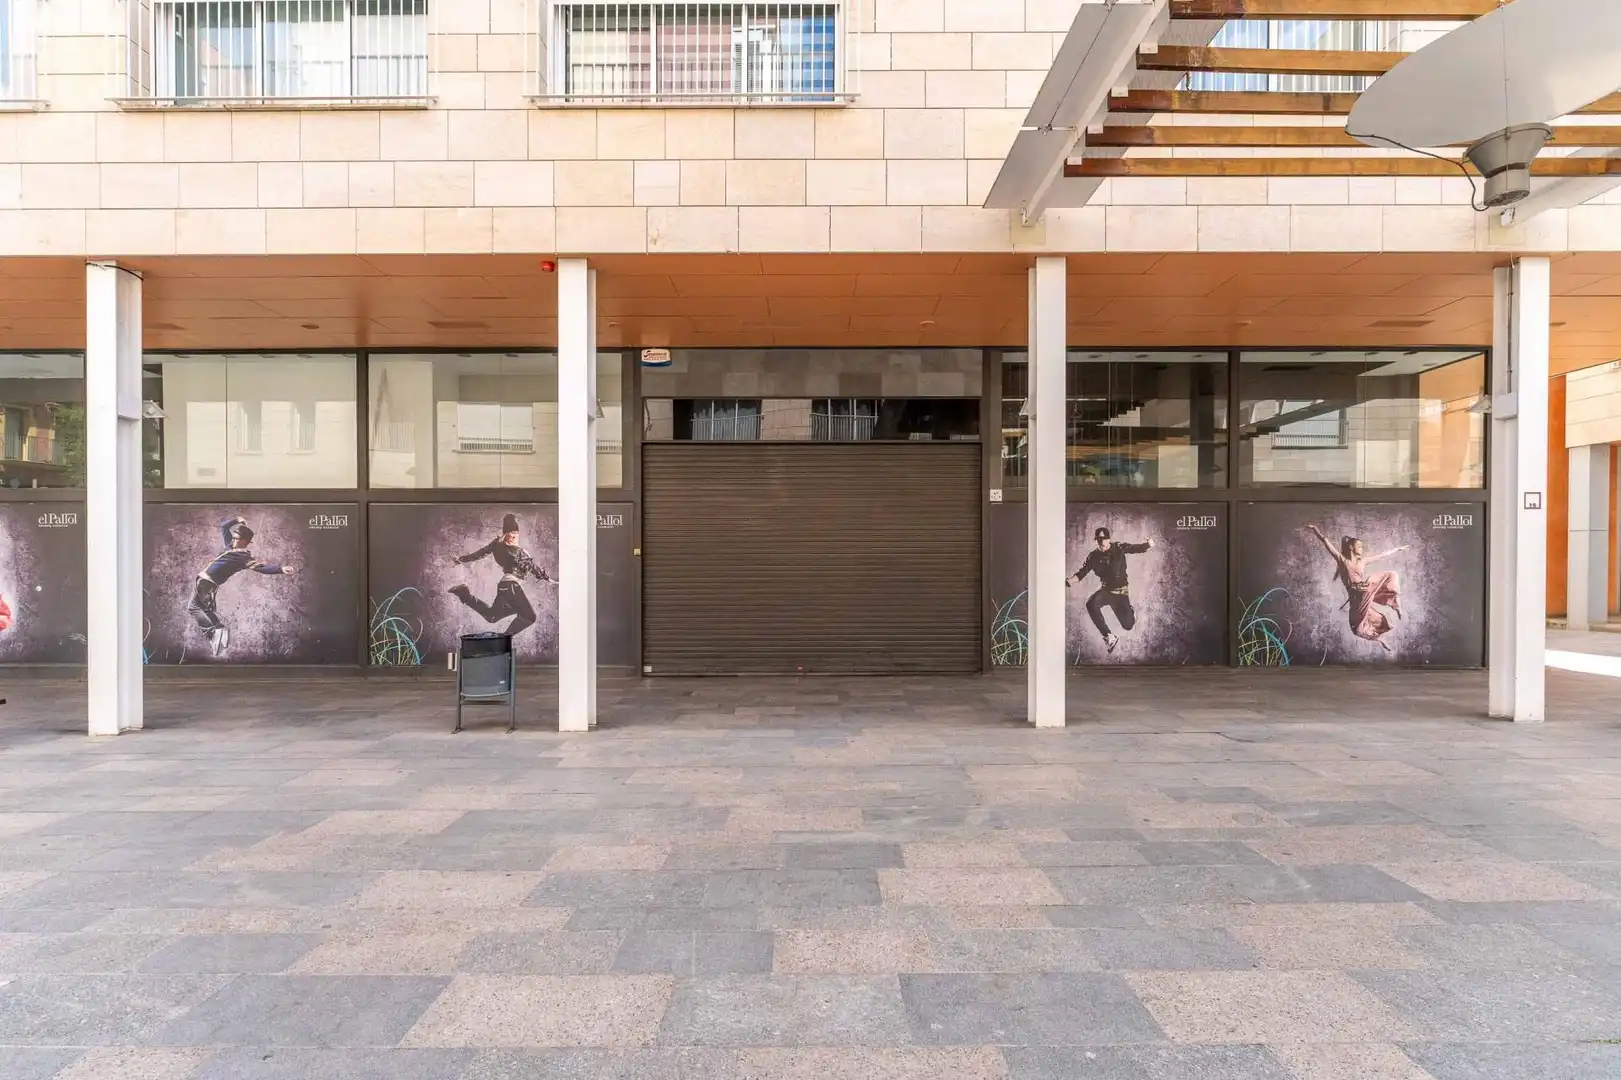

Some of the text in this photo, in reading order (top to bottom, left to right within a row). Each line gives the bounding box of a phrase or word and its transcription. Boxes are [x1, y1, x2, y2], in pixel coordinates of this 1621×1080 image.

[38, 513, 77, 525] el Pallol
[309, 515, 348, 527] el Pallol
[596, 514, 623, 526] Pallol
[1176, 516, 1216, 527] el Pallol
[1432, 515, 1472, 526] el Pallol
